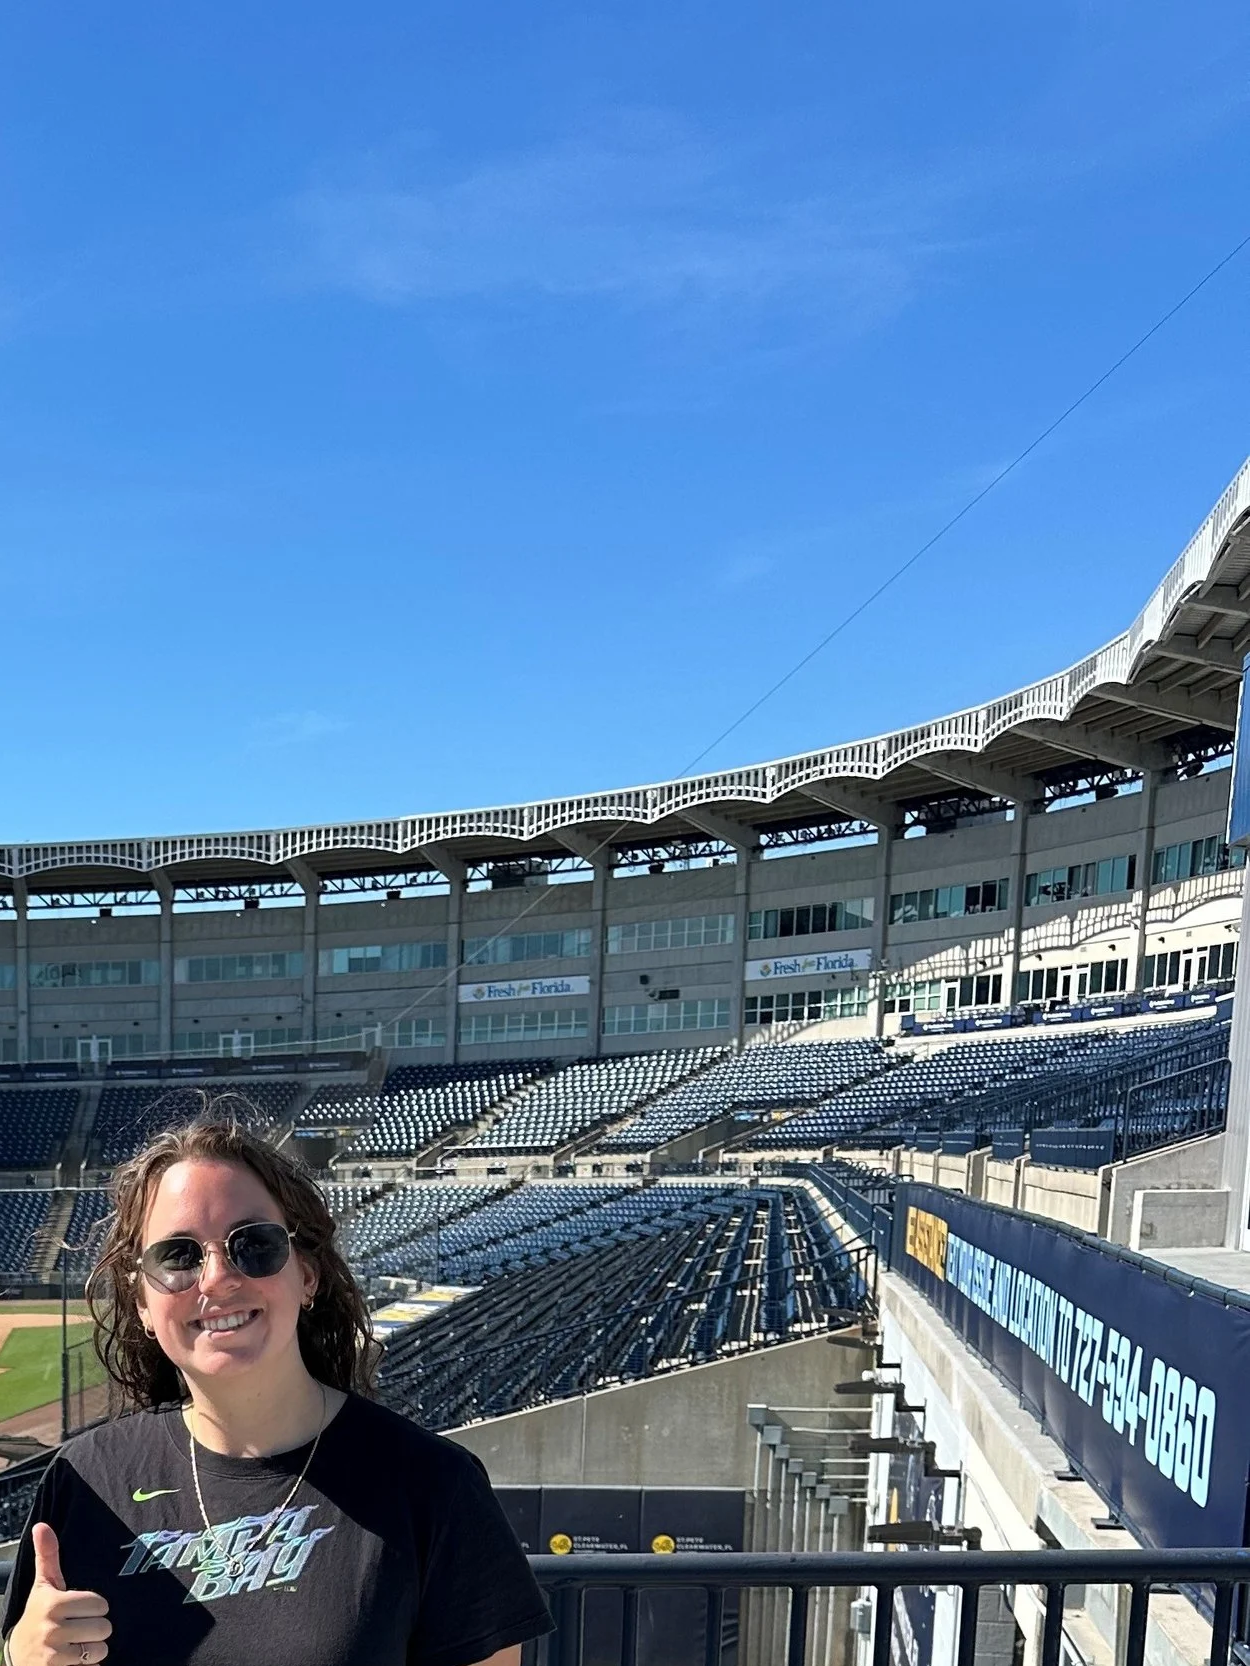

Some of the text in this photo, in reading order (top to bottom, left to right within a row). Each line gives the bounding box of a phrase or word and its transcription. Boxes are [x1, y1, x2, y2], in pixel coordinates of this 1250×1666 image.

[487, 984, 516, 998] Fresh
[531, 980, 572, 995] Florida
[773, 959, 801, 975] Fresh
[816, 954, 855, 971] Florida
[991, 1259, 1013, 1329] AND
[1008, 1267, 1060, 1369] LOCATION
[1055, 1295, 1074, 1384] TO
[1070, 1307, 1217, 1508] 727-594-0860
[118, 1504, 319, 1577] TAMPA
[183, 1525, 335, 1604] BAY
